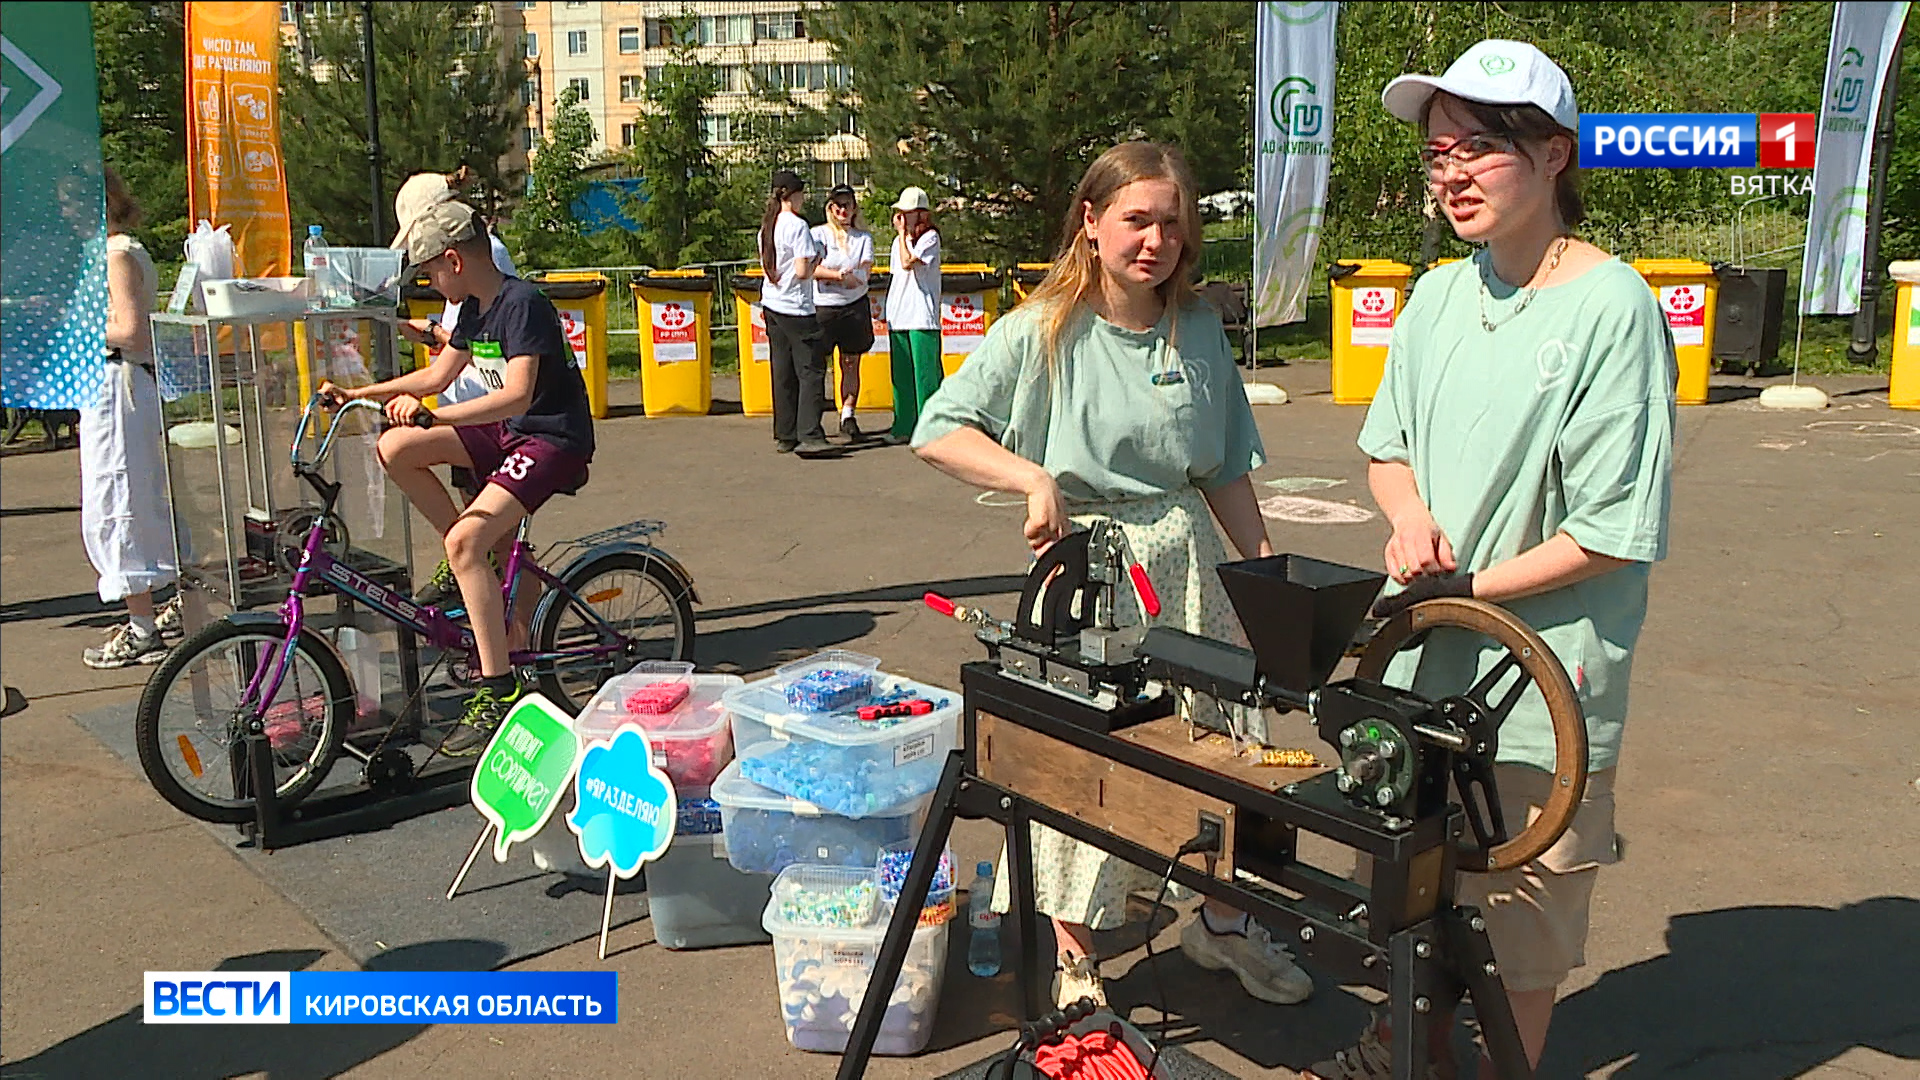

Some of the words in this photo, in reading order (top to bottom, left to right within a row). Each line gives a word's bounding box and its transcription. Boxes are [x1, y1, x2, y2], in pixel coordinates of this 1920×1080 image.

[203, 38, 232, 53] ЧИСТО
[1262, 140, 1276, 154] АО
[328, 563, 418, 621] STELS
